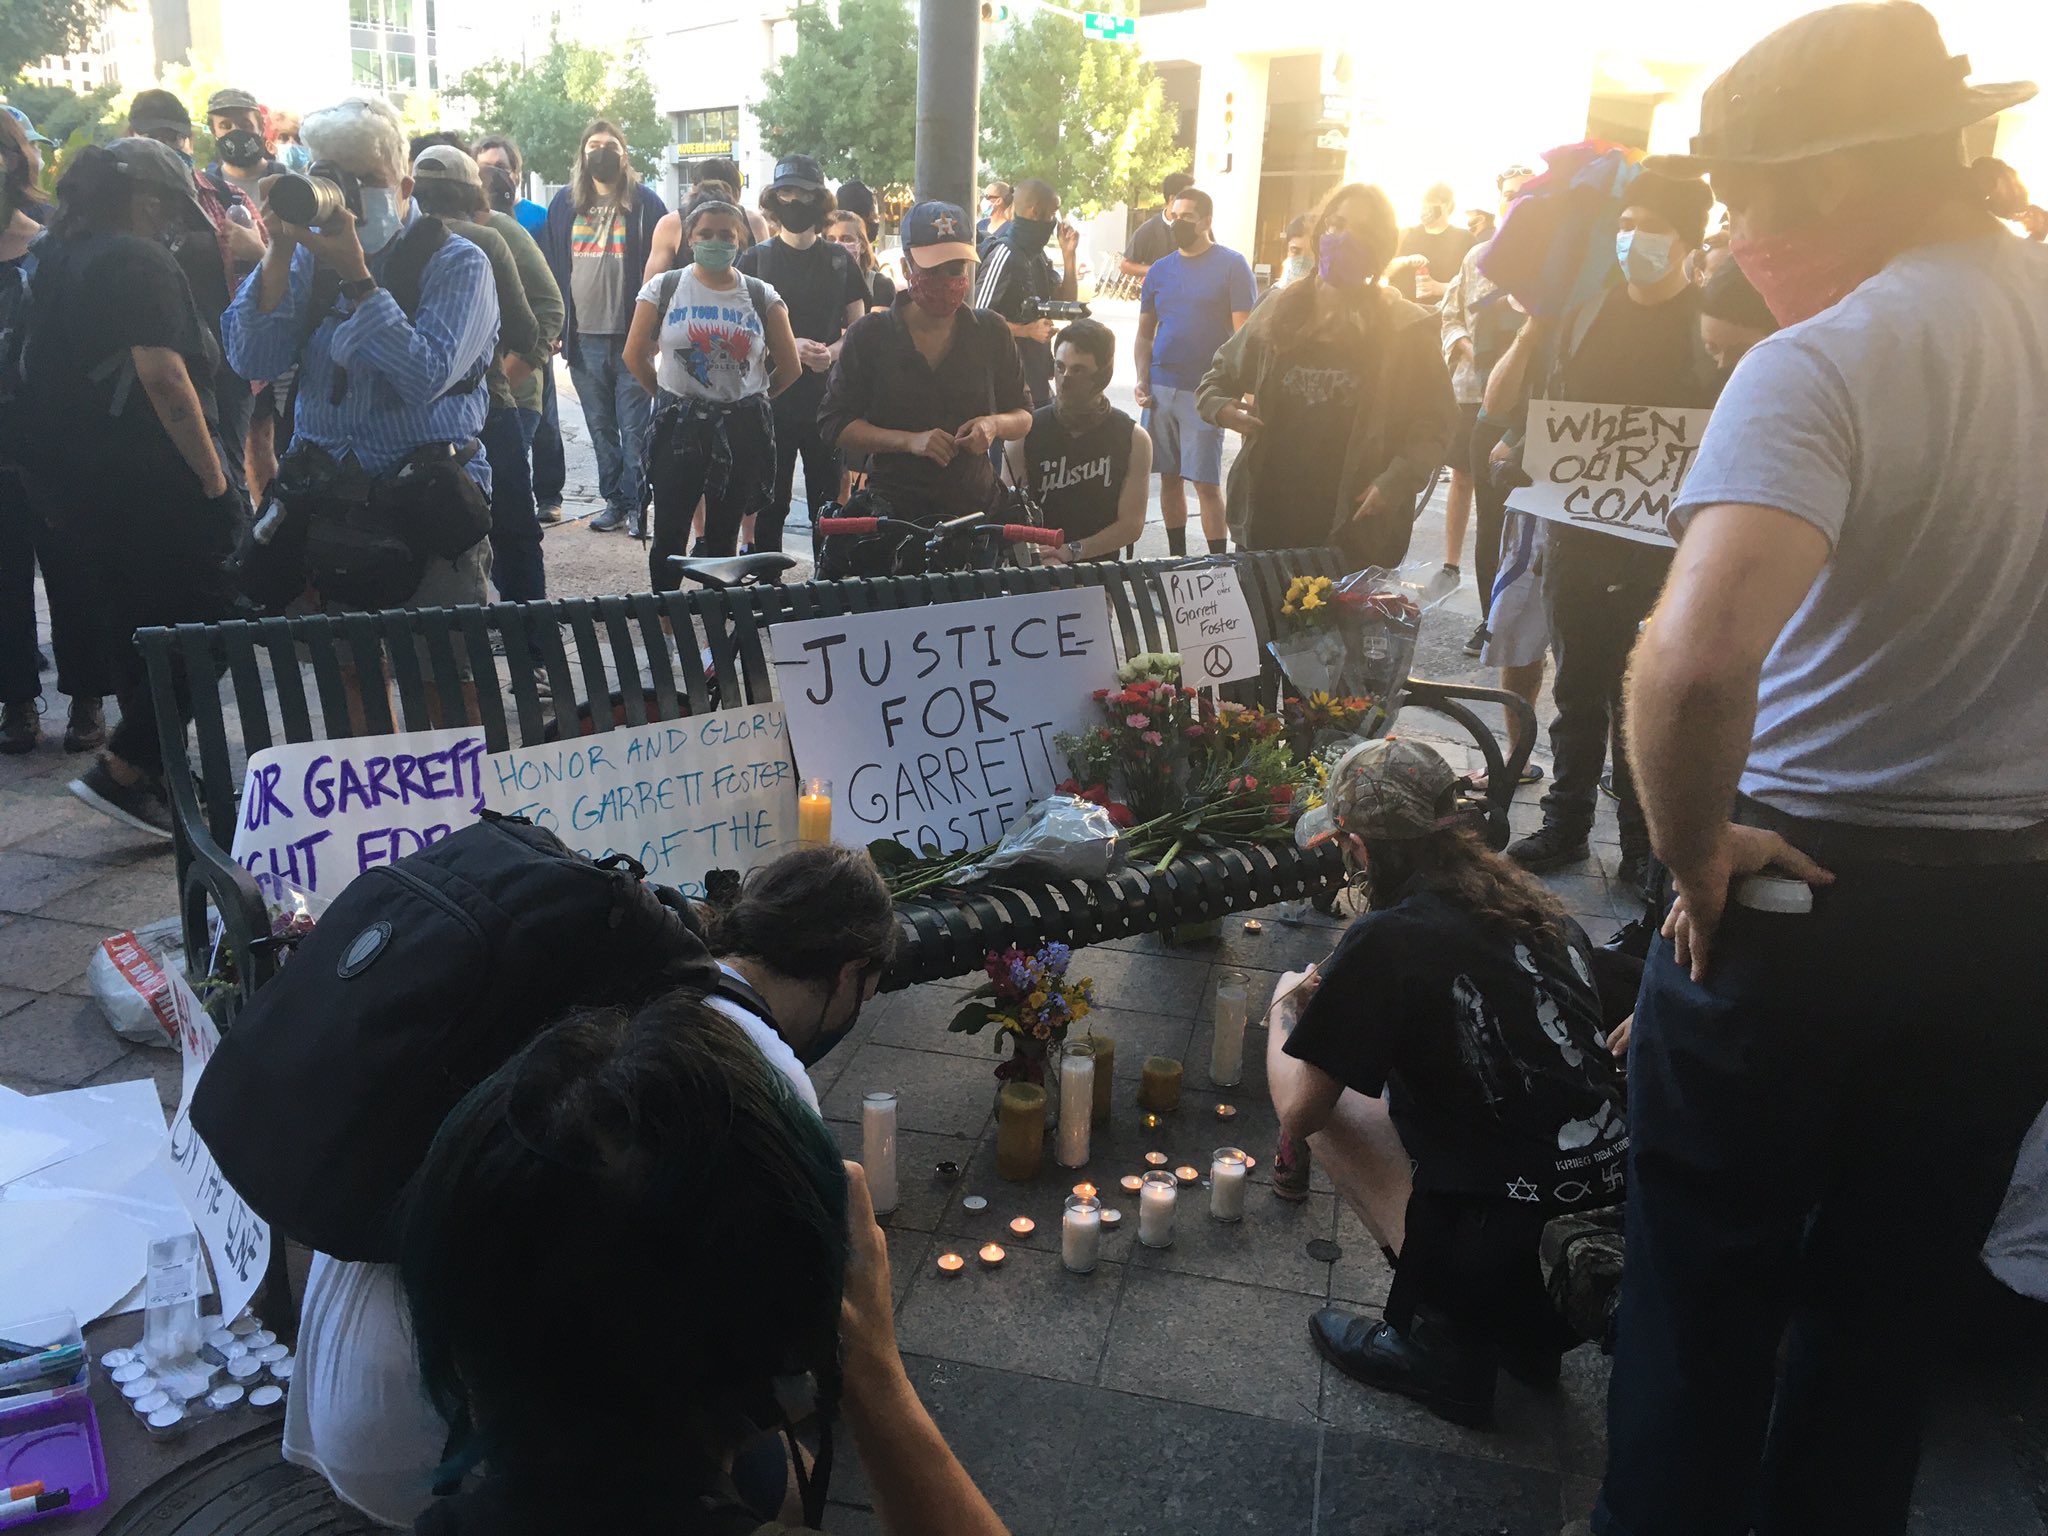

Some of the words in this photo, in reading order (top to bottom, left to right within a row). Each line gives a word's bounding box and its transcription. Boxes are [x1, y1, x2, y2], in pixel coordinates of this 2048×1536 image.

[691, 305, 719, 320] YOUR
[722, 307, 743, 325] DAY
[1563, 486, 1677, 524] COM
[1170, 574, 1214, 604] RIP
[1175, 600, 1218, 627] Garrett
[1199, 618, 1240, 637] Foster
[803, 613, 1088, 704] JUSTICE
[882, 679, 1009, 748] FOR
[493, 745, 616, 796] HONOR
[627, 729, 688, 764] AND
[701, 711, 784, 746] GLORY
[849, 722, 1058, 823] GARRETT
[572, 771, 704, 831] GARRETT
[711, 760, 791, 799] FOSTER
[640, 829, 688, 876] OF
[694, 810, 777, 856] THE
[1555, 1155, 1592, 1171] KRIEG
[1593, 1147, 1614, 1162] DEM
